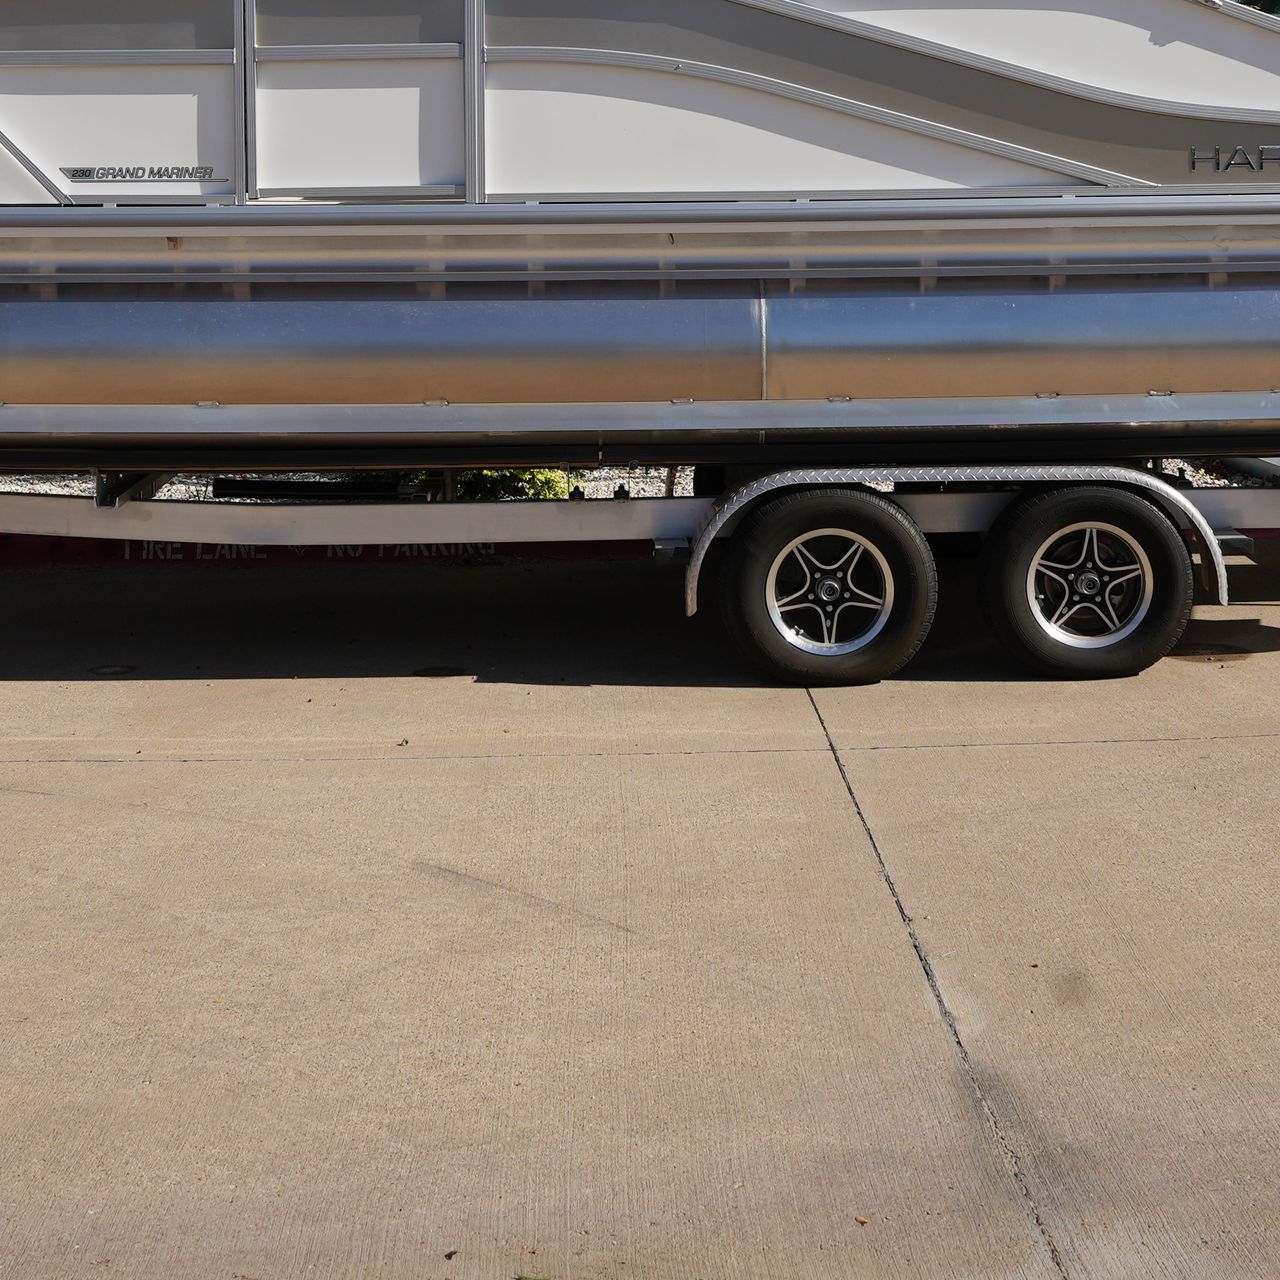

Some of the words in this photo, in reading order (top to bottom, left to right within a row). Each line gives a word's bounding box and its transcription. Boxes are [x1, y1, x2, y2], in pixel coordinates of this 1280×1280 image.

[71, 169, 92, 178] 230
[95, 167, 146, 179] GRAND
[148, 167, 214, 179] MARINER
